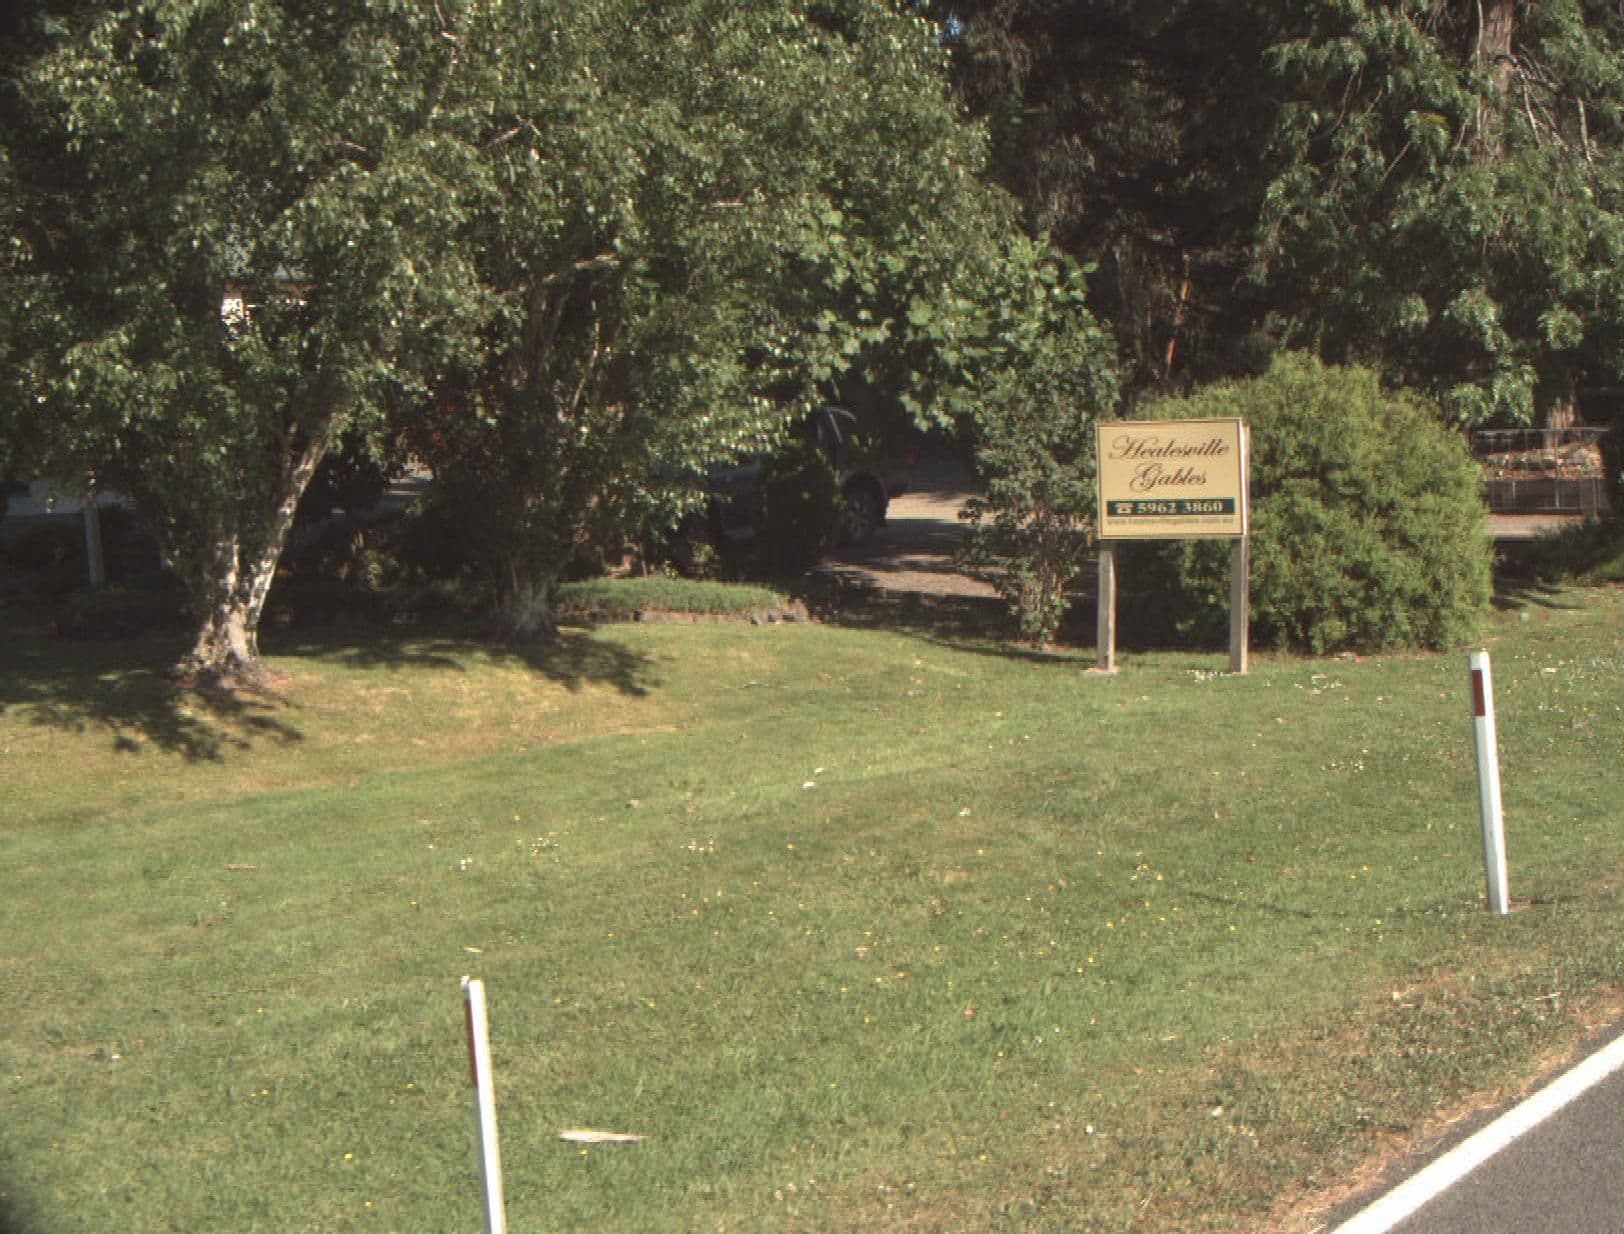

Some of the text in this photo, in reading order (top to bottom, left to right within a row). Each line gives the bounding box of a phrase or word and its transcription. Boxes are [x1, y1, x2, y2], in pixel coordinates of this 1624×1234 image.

[1108, 435, 1230, 459] Healesville
[1129, 463, 1207, 493] Gables
[1137, 502, 1177, 514] 5962
